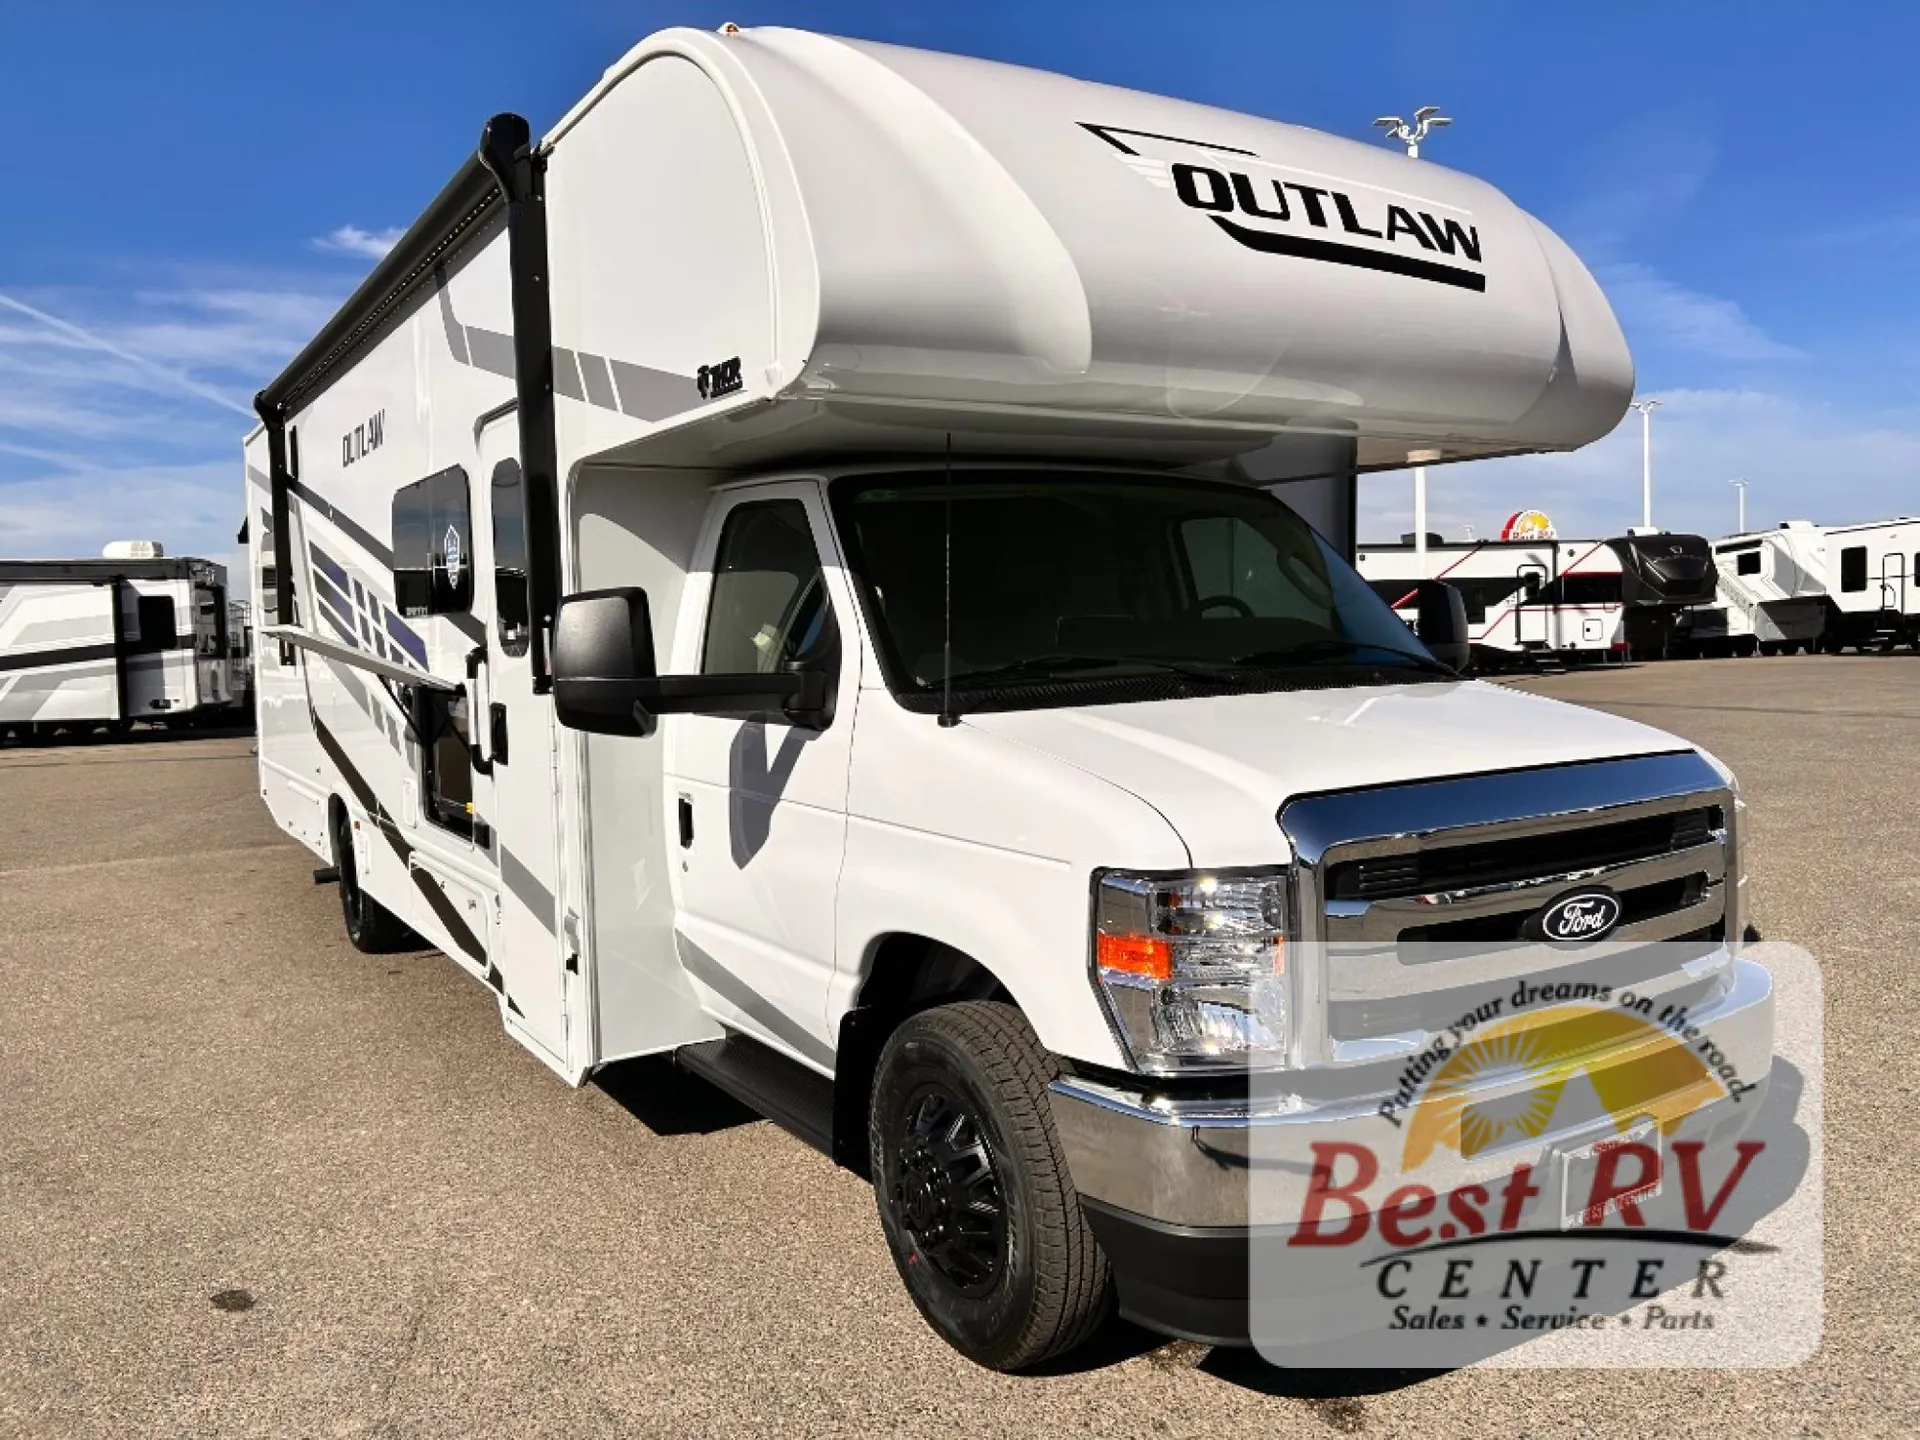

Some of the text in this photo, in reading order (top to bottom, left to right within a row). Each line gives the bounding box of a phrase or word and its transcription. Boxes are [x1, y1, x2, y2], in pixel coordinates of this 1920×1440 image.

[1171, 162, 1483, 263] OUTLAW
[342, 408, 385, 468] OUTLAW
[1558, 900, 1606, 935] Ford
